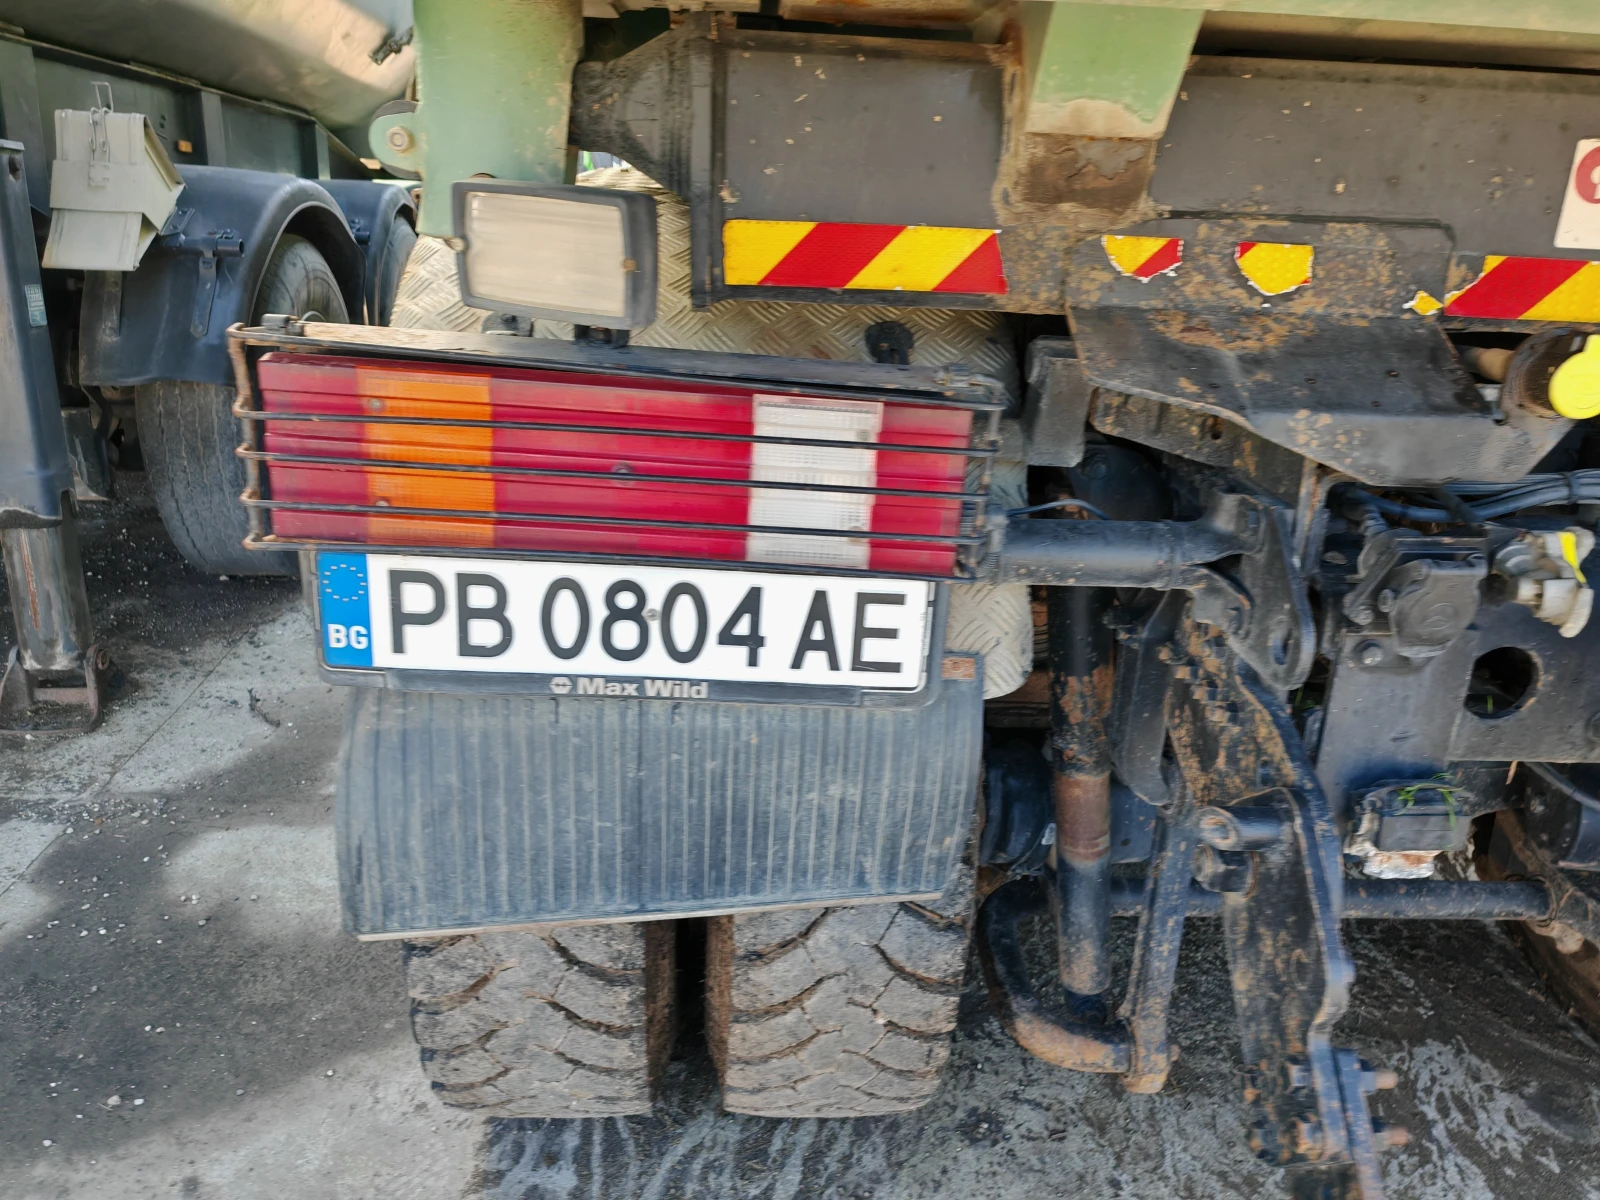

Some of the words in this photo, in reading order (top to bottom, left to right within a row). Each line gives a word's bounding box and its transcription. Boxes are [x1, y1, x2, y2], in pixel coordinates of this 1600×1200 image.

[389, 570, 512, 658] PB
[541, 577, 766, 667] 0804
[790, 589, 906, 673] AE
[327, 623, 369, 650] BG
[576, 677, 640, 696] Max
[644, 679, 708, 699] Wild
